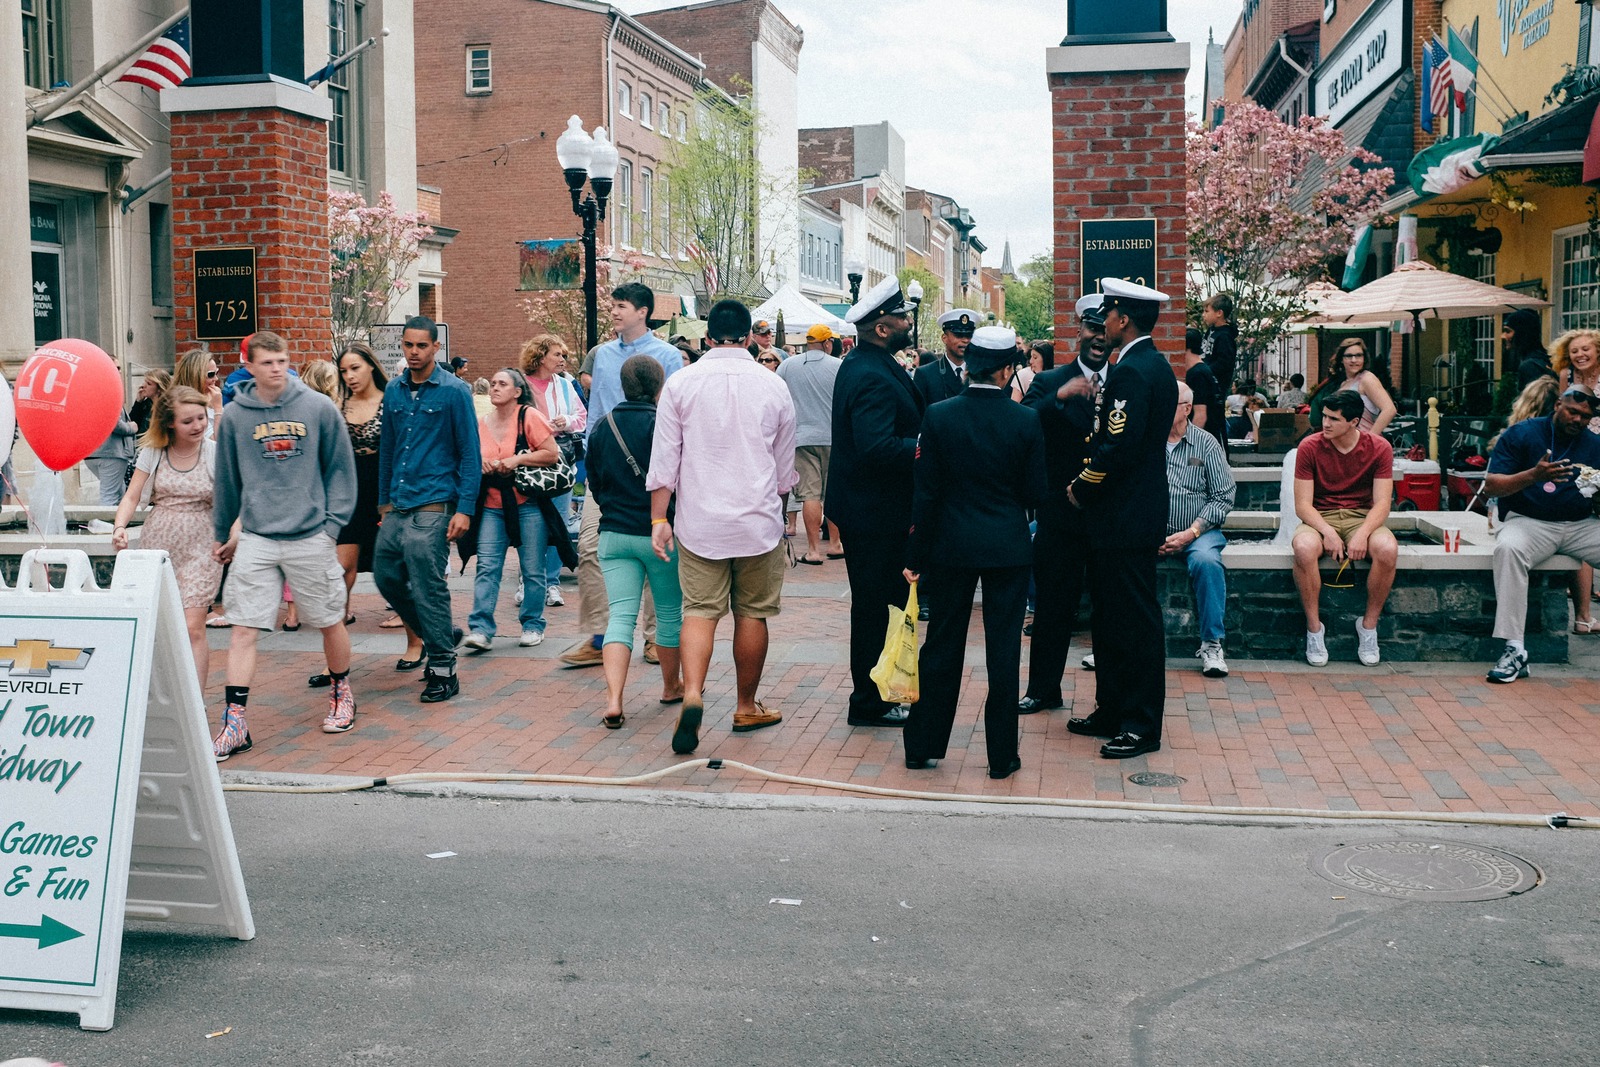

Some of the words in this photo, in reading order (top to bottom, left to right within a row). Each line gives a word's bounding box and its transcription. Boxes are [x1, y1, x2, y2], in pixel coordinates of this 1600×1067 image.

[1341, 54, 1362, 97] FLOOR
[1367, 29, 1386, 73] SHOP
[37, 216, 56, 229] BANK
[1085, 238, 1153, 250] ESTABLISHED
[197, 265, 252, 277] ESTABLISHED
[34, 302, 53, 310] ATIONAL
[35, 308, 48, 317] BANK
[205, 300, 248, 323] 1752
[252, 421, 307, 440] JACKETS
[0, 680, 84, 695] EVROLET
[22, 704, 95, 738] Town
[0, 820, 98, 858] Games
[4, 865, 32, 896] &
[37, 866, 90, 900] Fun
